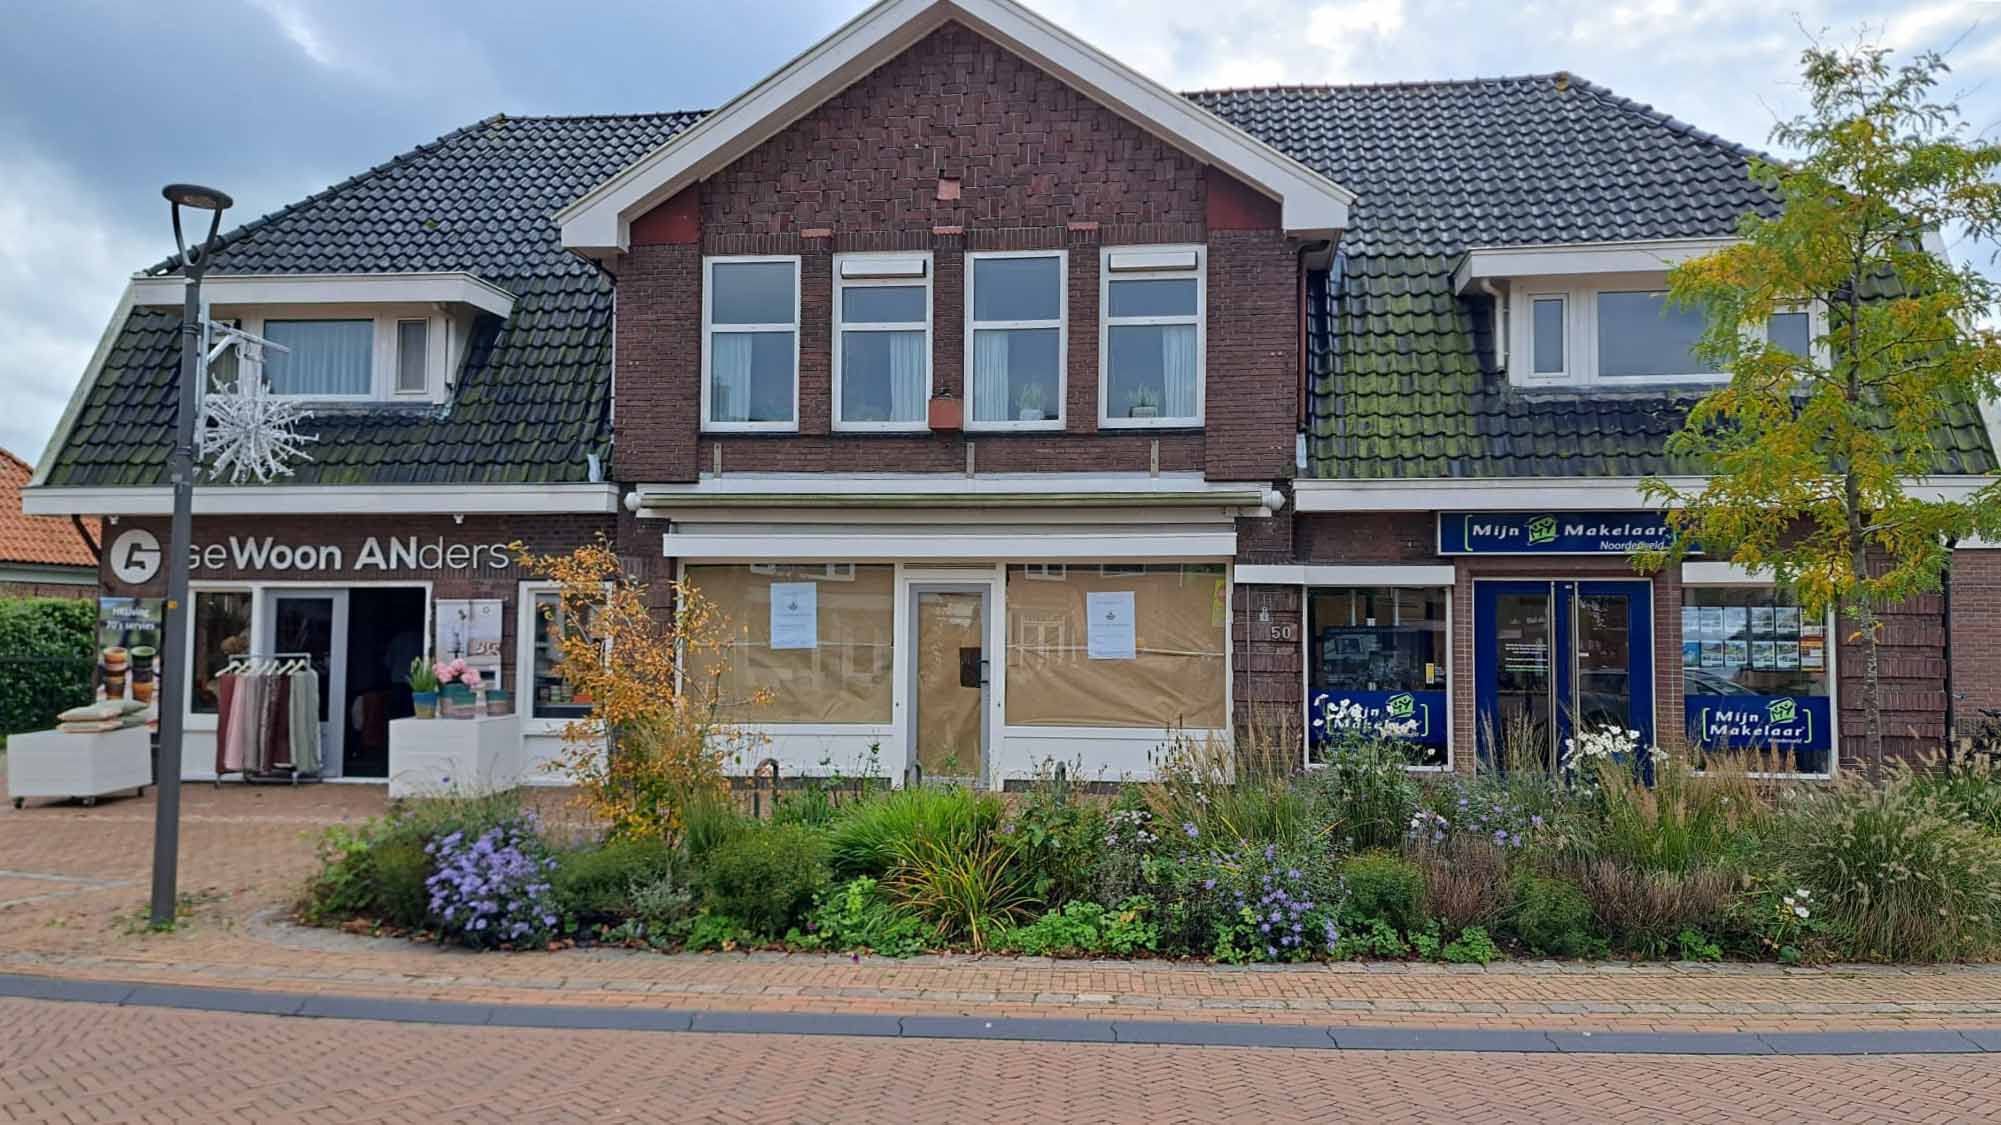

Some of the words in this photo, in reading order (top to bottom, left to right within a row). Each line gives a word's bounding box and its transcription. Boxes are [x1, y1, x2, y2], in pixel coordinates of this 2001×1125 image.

[1472, 525, 1519, 539] Mijn
[1564, 524, 1667, 536] Makelaar
[1600, 540, 1665, 550] Noordeeld
[353, 536, 510, 570] ANders
[1271, 626, 1291, 639] 50
[1715, 711, 1759, 725] Mijn
[1710, 725, 1804, 737] Makelaar
